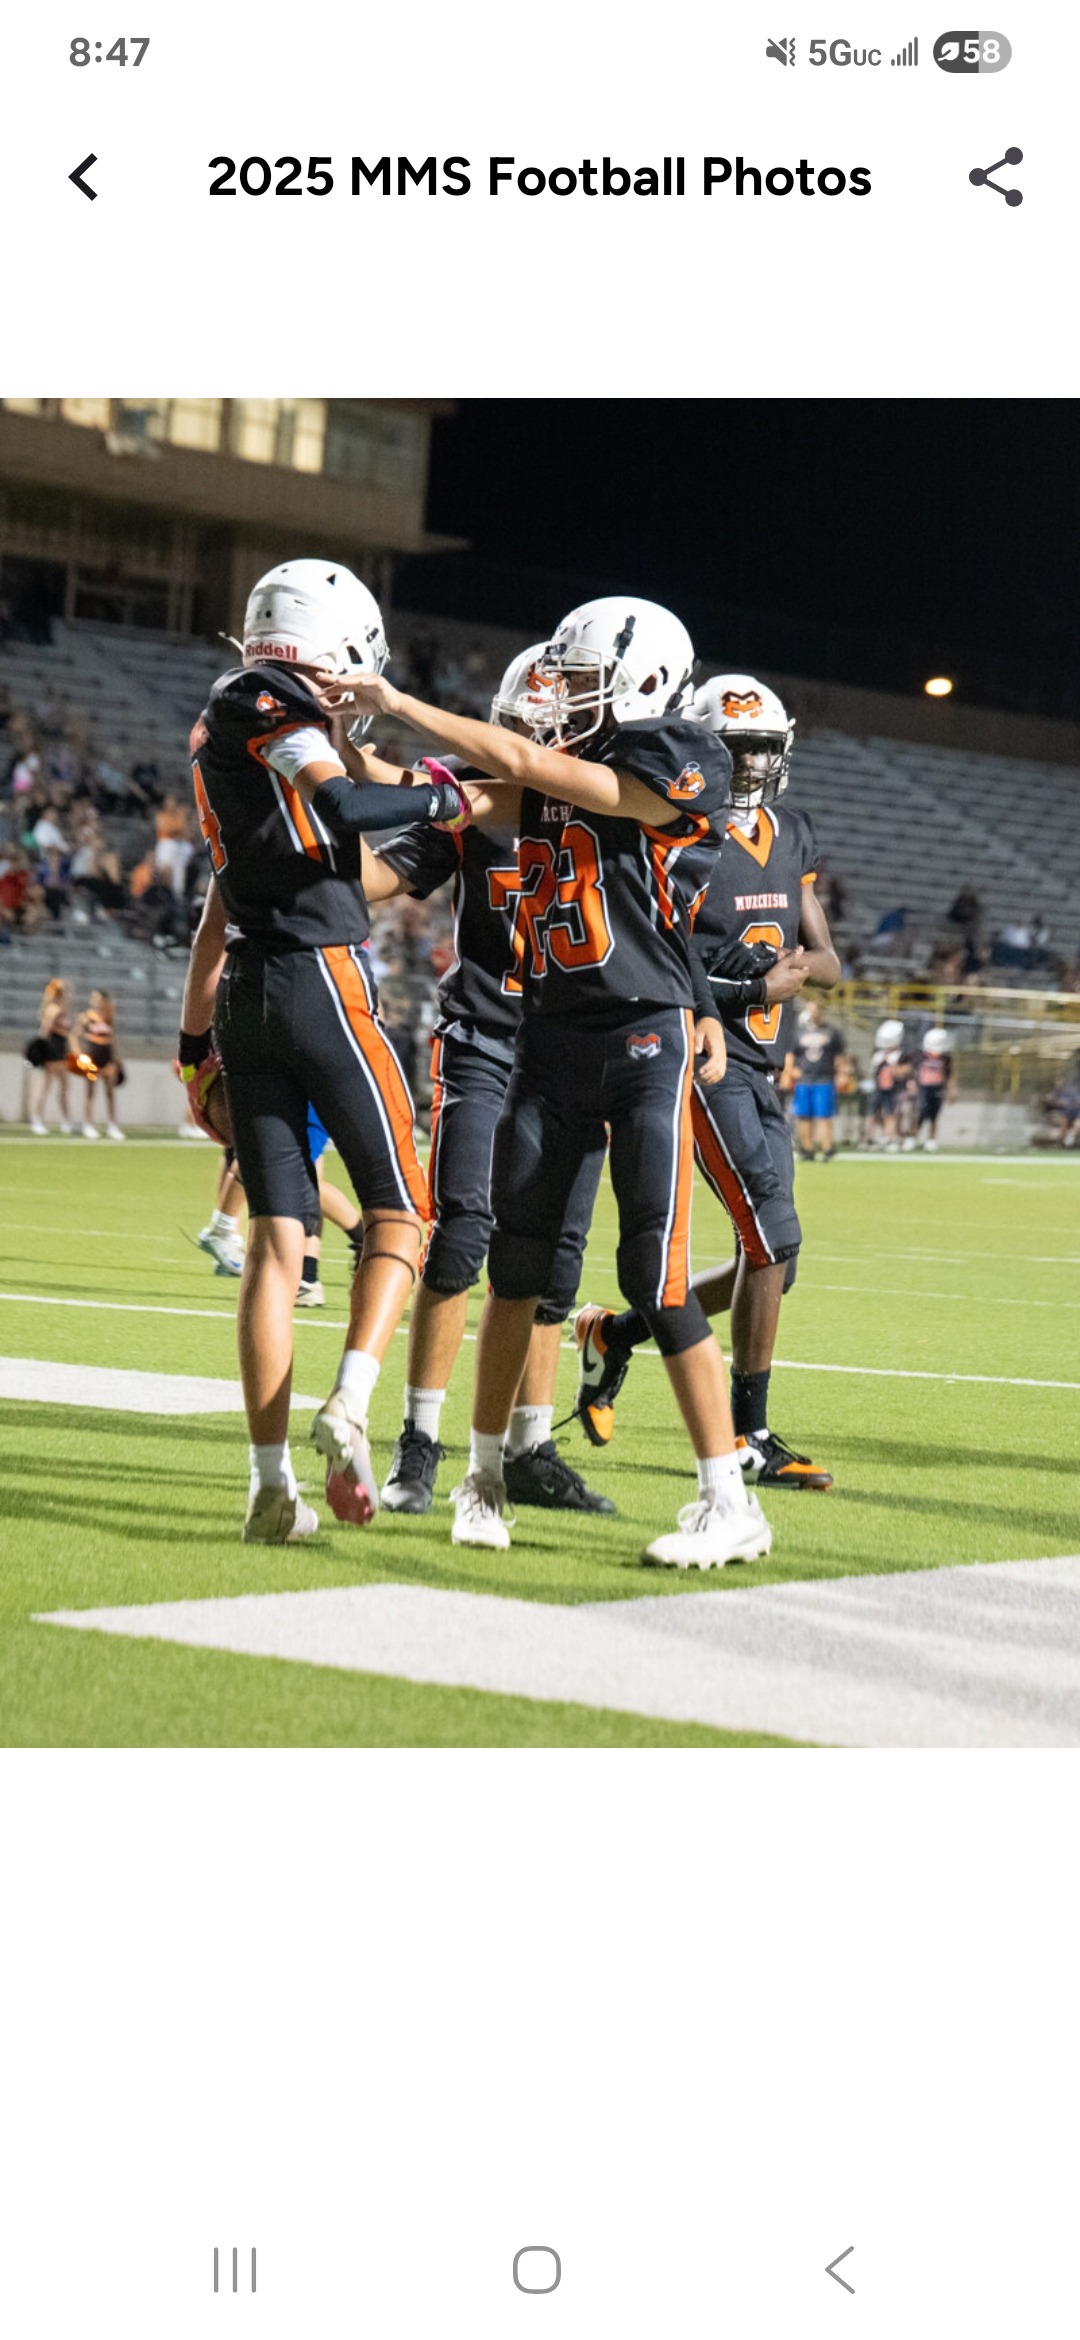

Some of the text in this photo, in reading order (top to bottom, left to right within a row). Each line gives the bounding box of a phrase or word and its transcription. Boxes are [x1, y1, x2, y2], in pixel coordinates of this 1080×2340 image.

[69, 37, 150, 67] 8:47
[963, 39, 1001, 64] 58
[208, 156, 872, 197] 2025 MMS Football Photos
[245, 641, 298, 661] Riddell
[518, 820, 615, 979] 23
